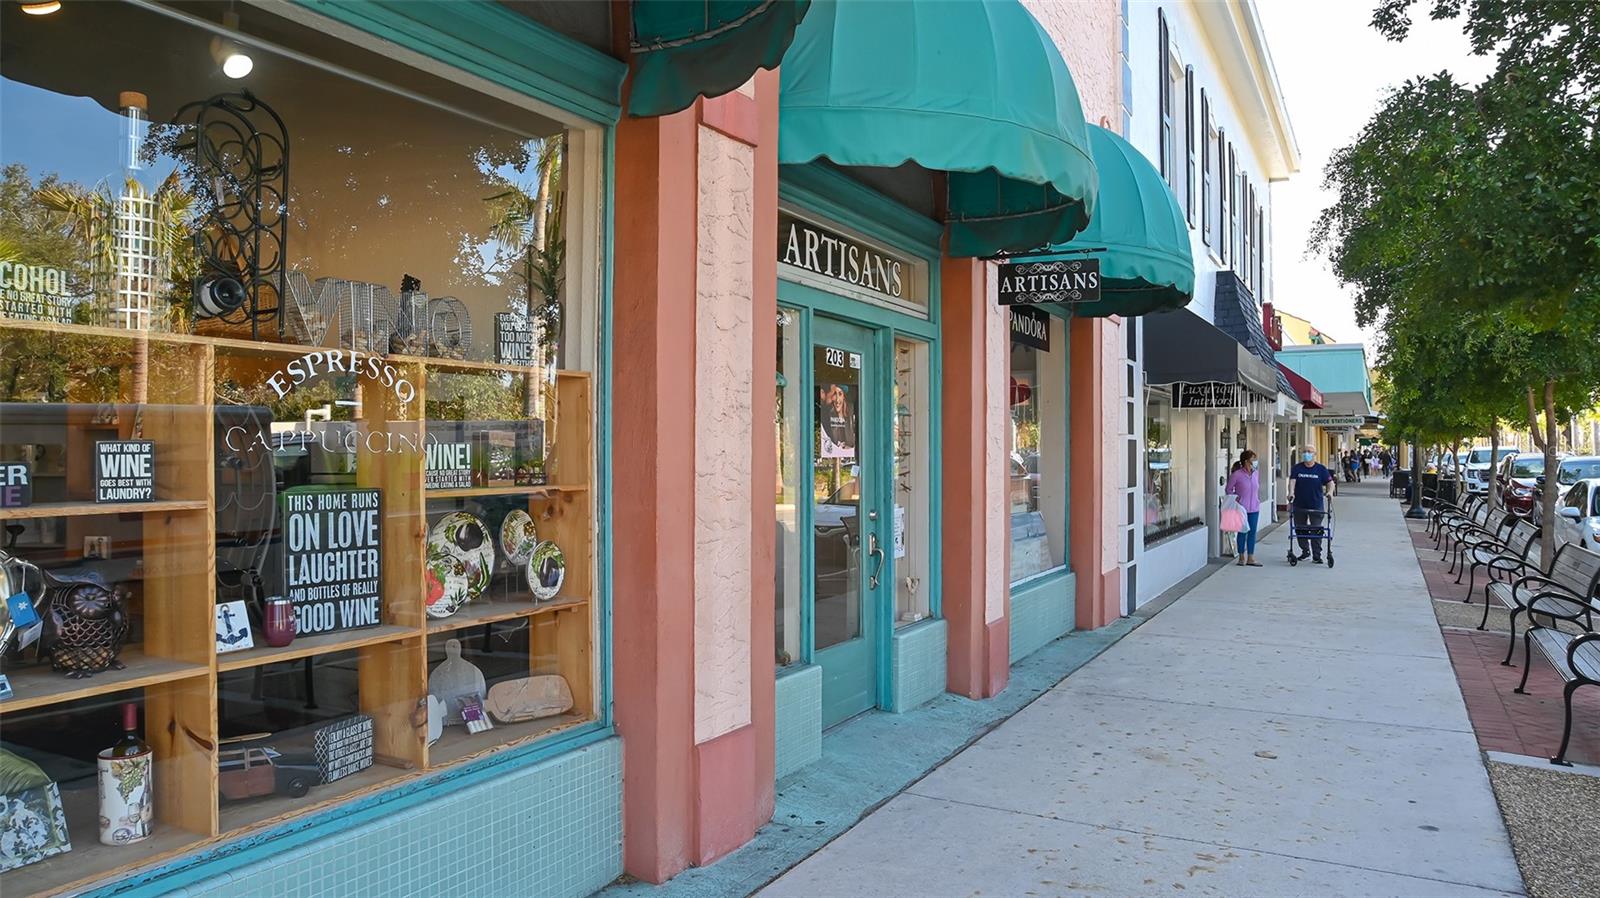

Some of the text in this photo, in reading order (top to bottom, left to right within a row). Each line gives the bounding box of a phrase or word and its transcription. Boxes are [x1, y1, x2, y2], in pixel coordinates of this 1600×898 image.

[783, 223, 901, 297] ARTISANS
[1000, 272, 1098, 293] ARTISANS
[20, 291, 45, 304] GREAT
[47, 295, 71, 307] STORY
[48, 306, 71, 317] WITH
[500, 331, 515, 342] TOO
[500, 343, 536, 360] WINE?
[827, 349, 844, 367] 203
[266, 350, 415, 403] ESPRESSO
[100, 443, 151, 453] WHAT KIND OF
[225, 426, 438, 454] CAPPUCCINO
[100, 454, 152, 478] WINE
[100, 479, 152, 487] GOES BEST WITH
[100, 487, 152, 500] LAUNDRY?
[288, 492, 379, 512] THIS HOME RUNS
[289, 509, 378, 552] ON LOVE
[289, 549, 378, 586] LAUGHTER
[289, 580, 378, 602] AND BOTTLES OF REALLY
[293, 602, 335, 635] GOOD
[339, 597, 380, 629] WINE
